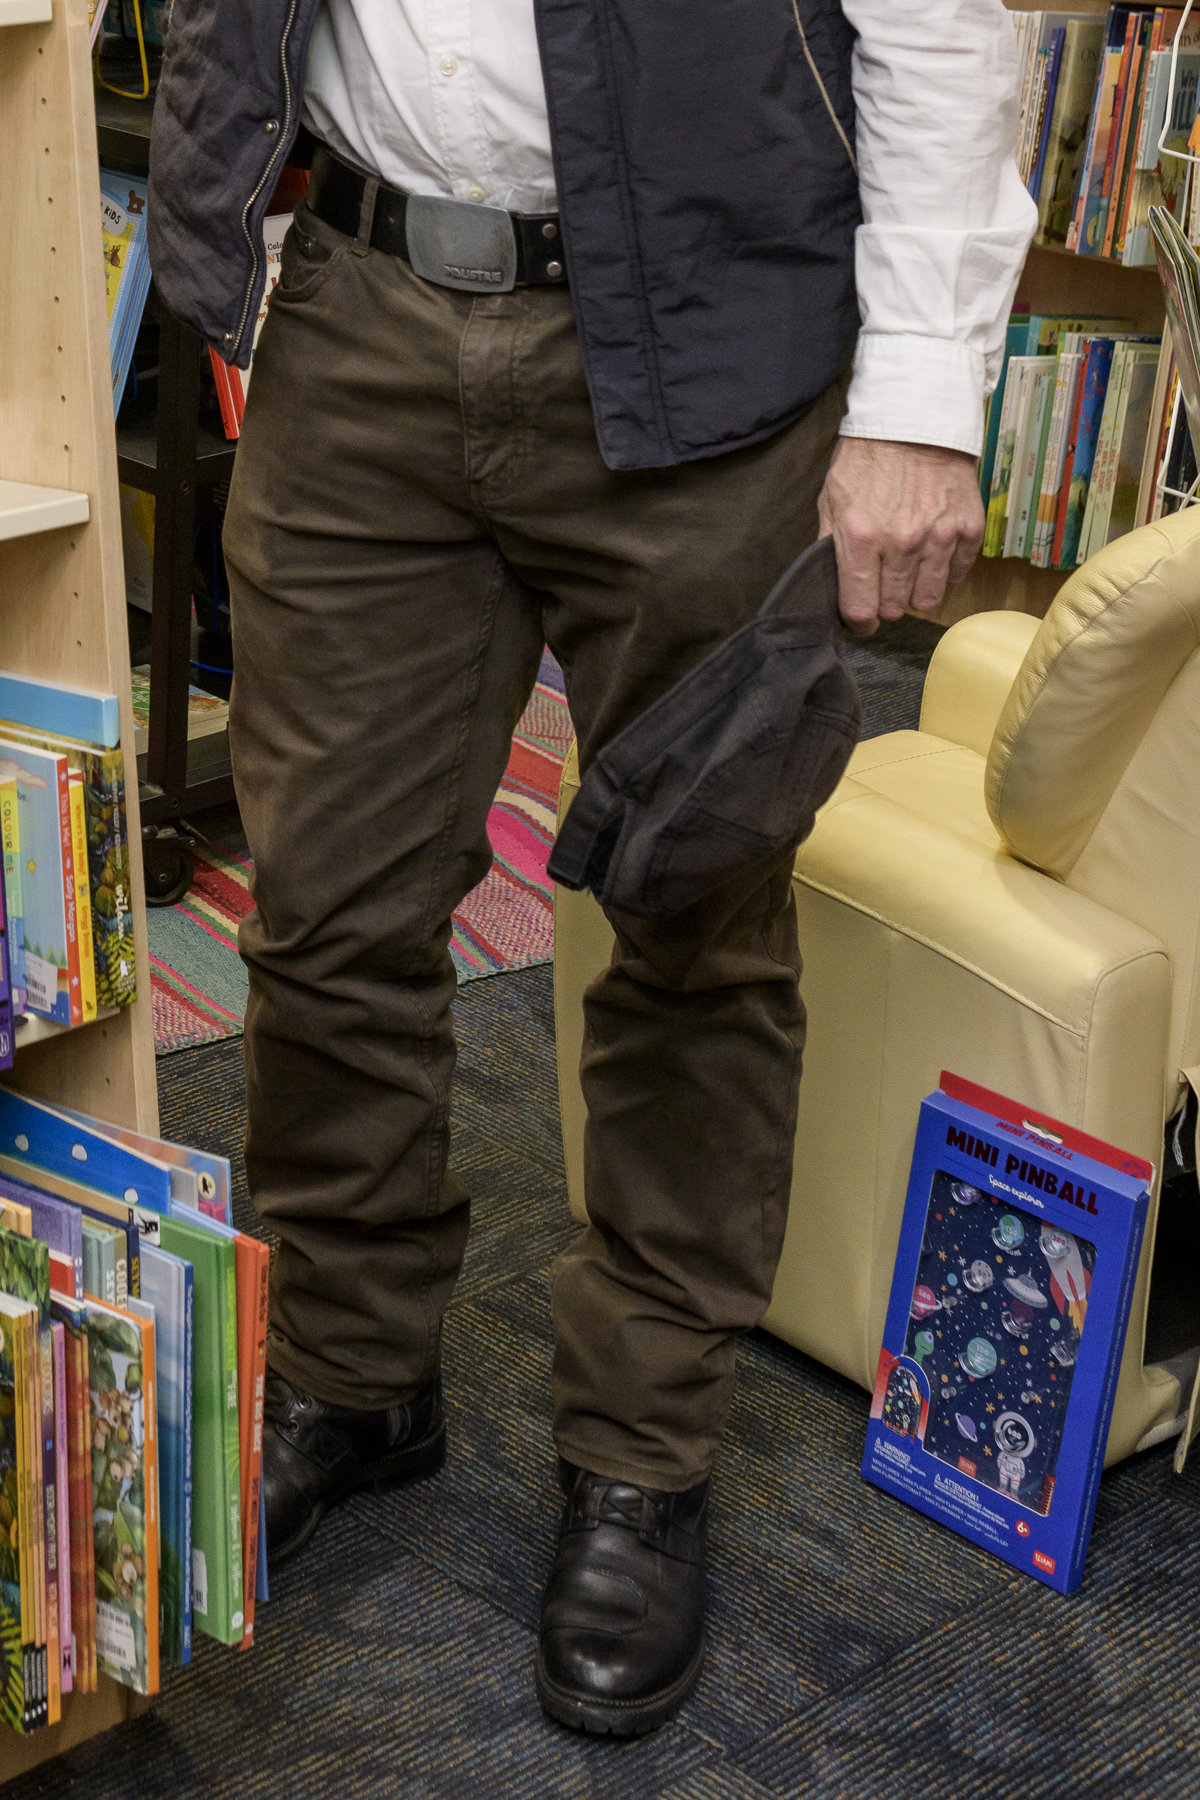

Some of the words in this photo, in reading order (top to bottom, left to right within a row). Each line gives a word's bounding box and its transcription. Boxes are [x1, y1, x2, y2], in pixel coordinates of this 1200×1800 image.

[2, 800, 13, 849] COLOUR
[5, 855, 15, 873] ME
[65, 875, 75, 899] Sally
[67, 901, 77, 942] Morgan
[995, 1120, 1026, 1139] MINI
[1026, 1134, 1075, 1161] PINBALL
[946, 1124, 1000, 1170] MINI
[1004, 1152, 1099, 1217] PINBALL
[988, 1173, 1012, 1193] Space
[1011, 1185, 1046, 1209] explorer
[1007, 1427, 1022, 1441] 600
[1017, 1520, 1029, 1535] 6+
